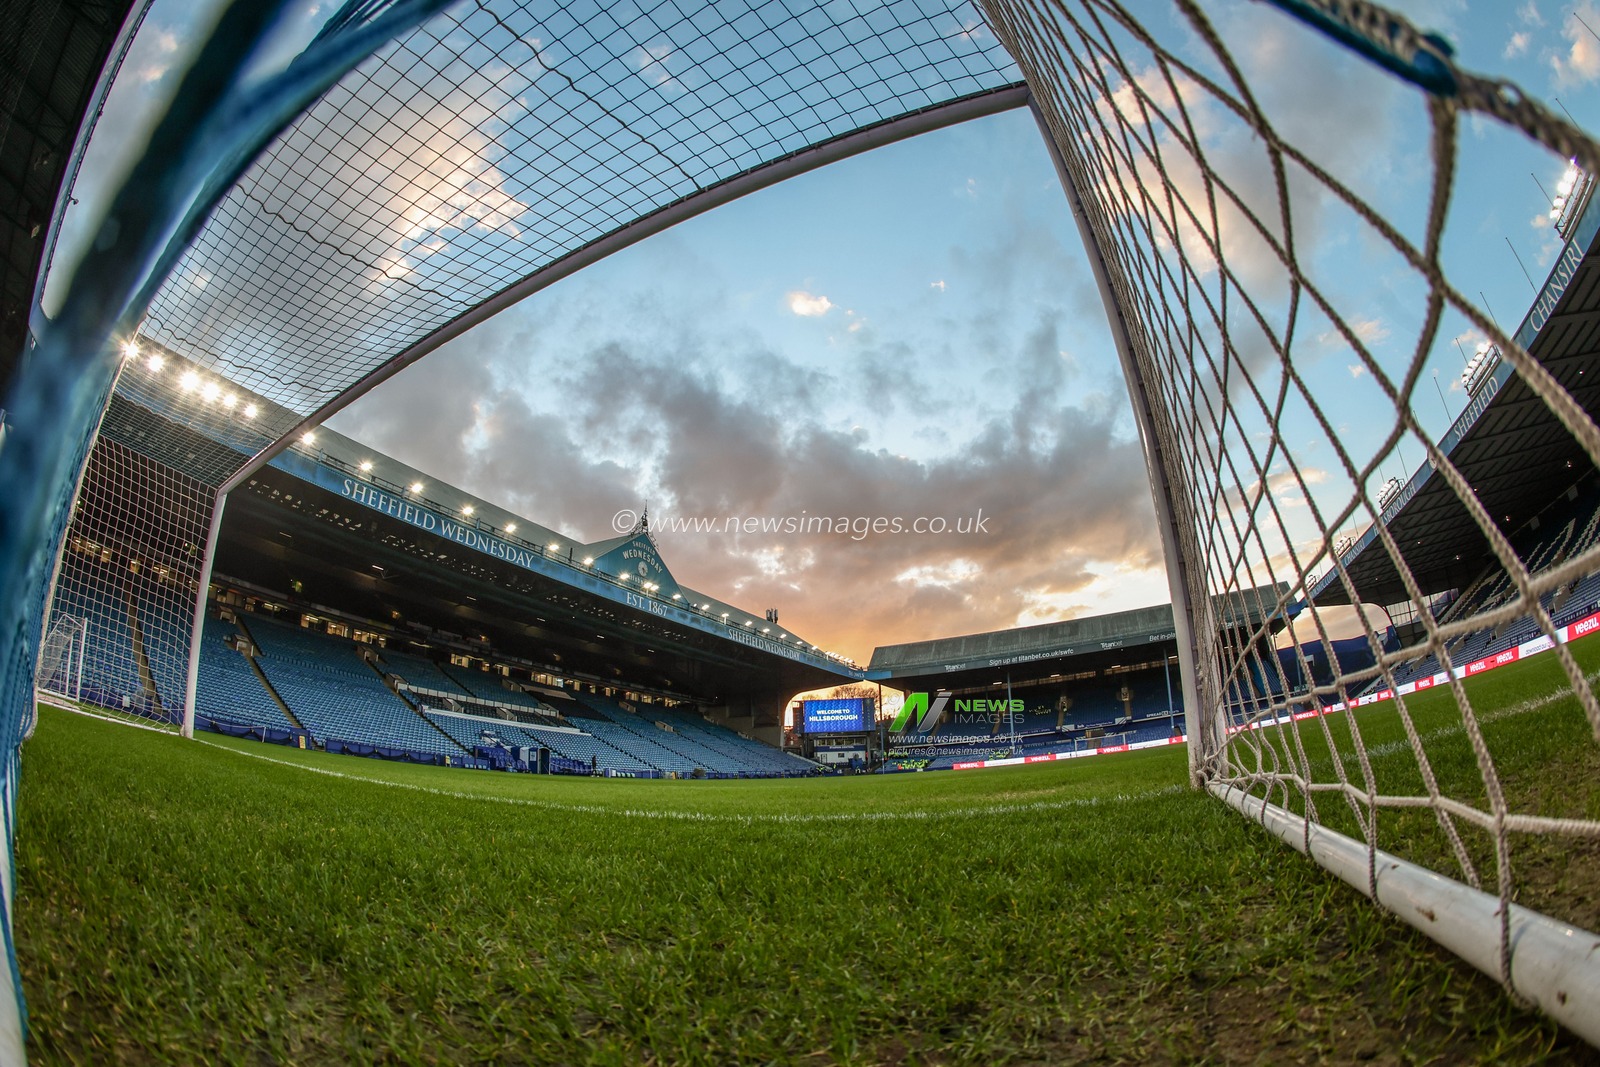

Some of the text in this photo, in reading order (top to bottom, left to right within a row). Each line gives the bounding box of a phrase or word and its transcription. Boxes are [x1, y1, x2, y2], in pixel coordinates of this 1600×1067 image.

[1530, 239, 1584, 332] CHANSIRI
[1453, 376, 1499, 442] SHEFFIELD
[341, 480, 534, 568] SHEFFIELD WEDNESDAY
[632, 541, 656, 556] SHEFFIELD
[622, 549, 663, 574] WEDNESDAY
[626, 592, 668, 617] EST. 1867
[1160, 632, 1176, 640] in-pla
[1574, 617, 1599, 635] veezu.
[728, 628, 801, 661] SHEFFIELD WEDNESDAY
